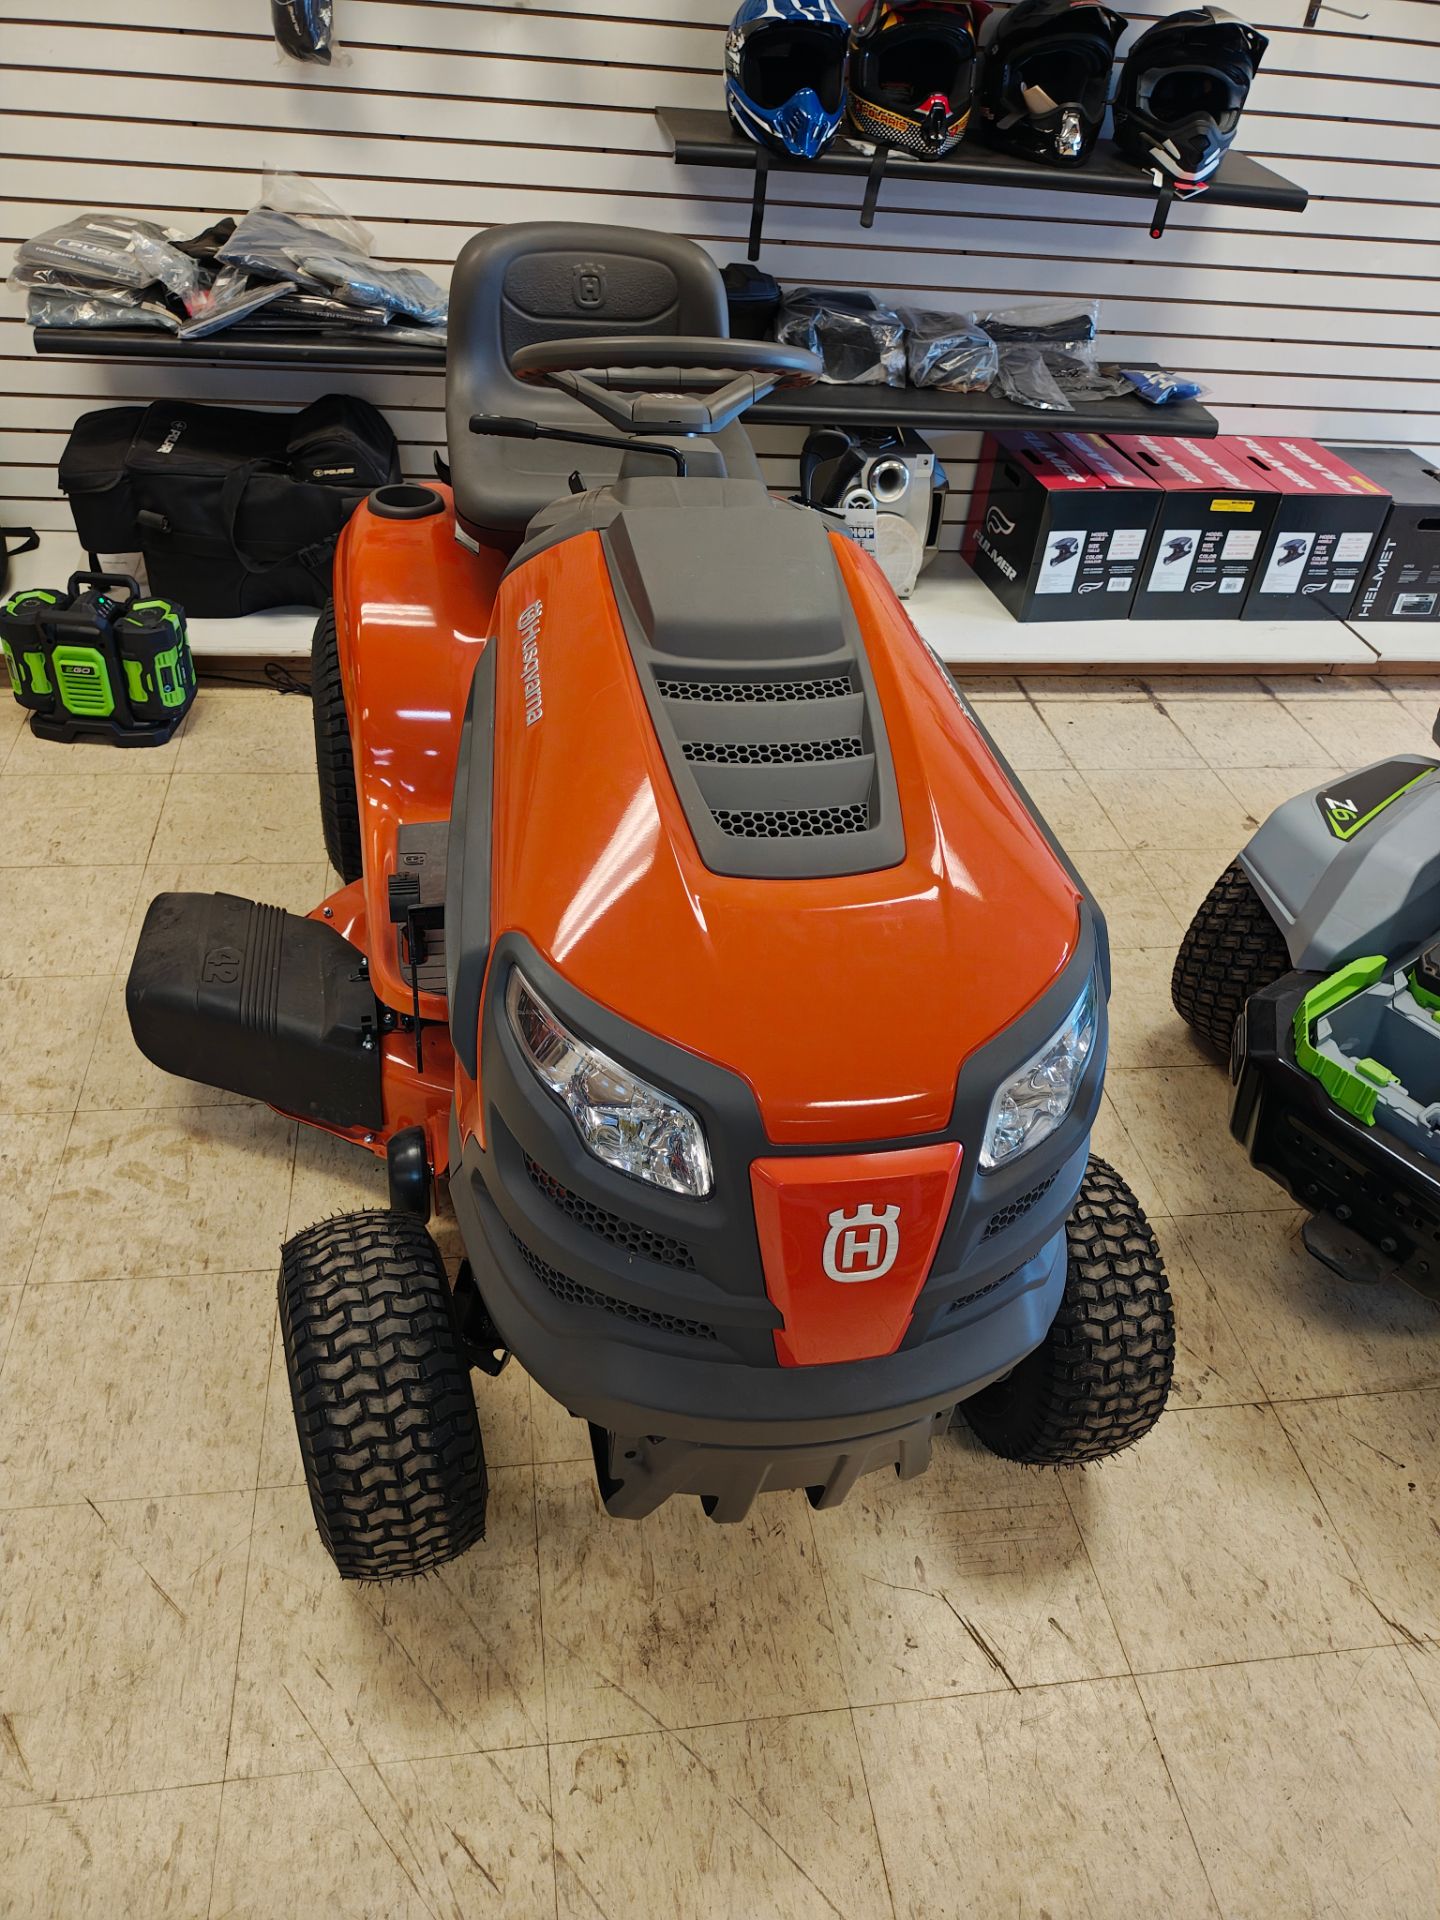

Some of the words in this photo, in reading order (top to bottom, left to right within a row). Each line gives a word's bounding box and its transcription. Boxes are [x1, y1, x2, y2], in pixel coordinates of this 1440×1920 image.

[1236, 436, 1318, 490] FULMER
[1279, 441, 1364, 494] FULMER
[972, 529, 1018, 581] FULMER
[1358, 538, 1397, 616] HELMET
[64, 666, 90, 674] EGO
[520, 619, 543, 727] Husqvarna
[1325, 797, 1358, 820] Z6
